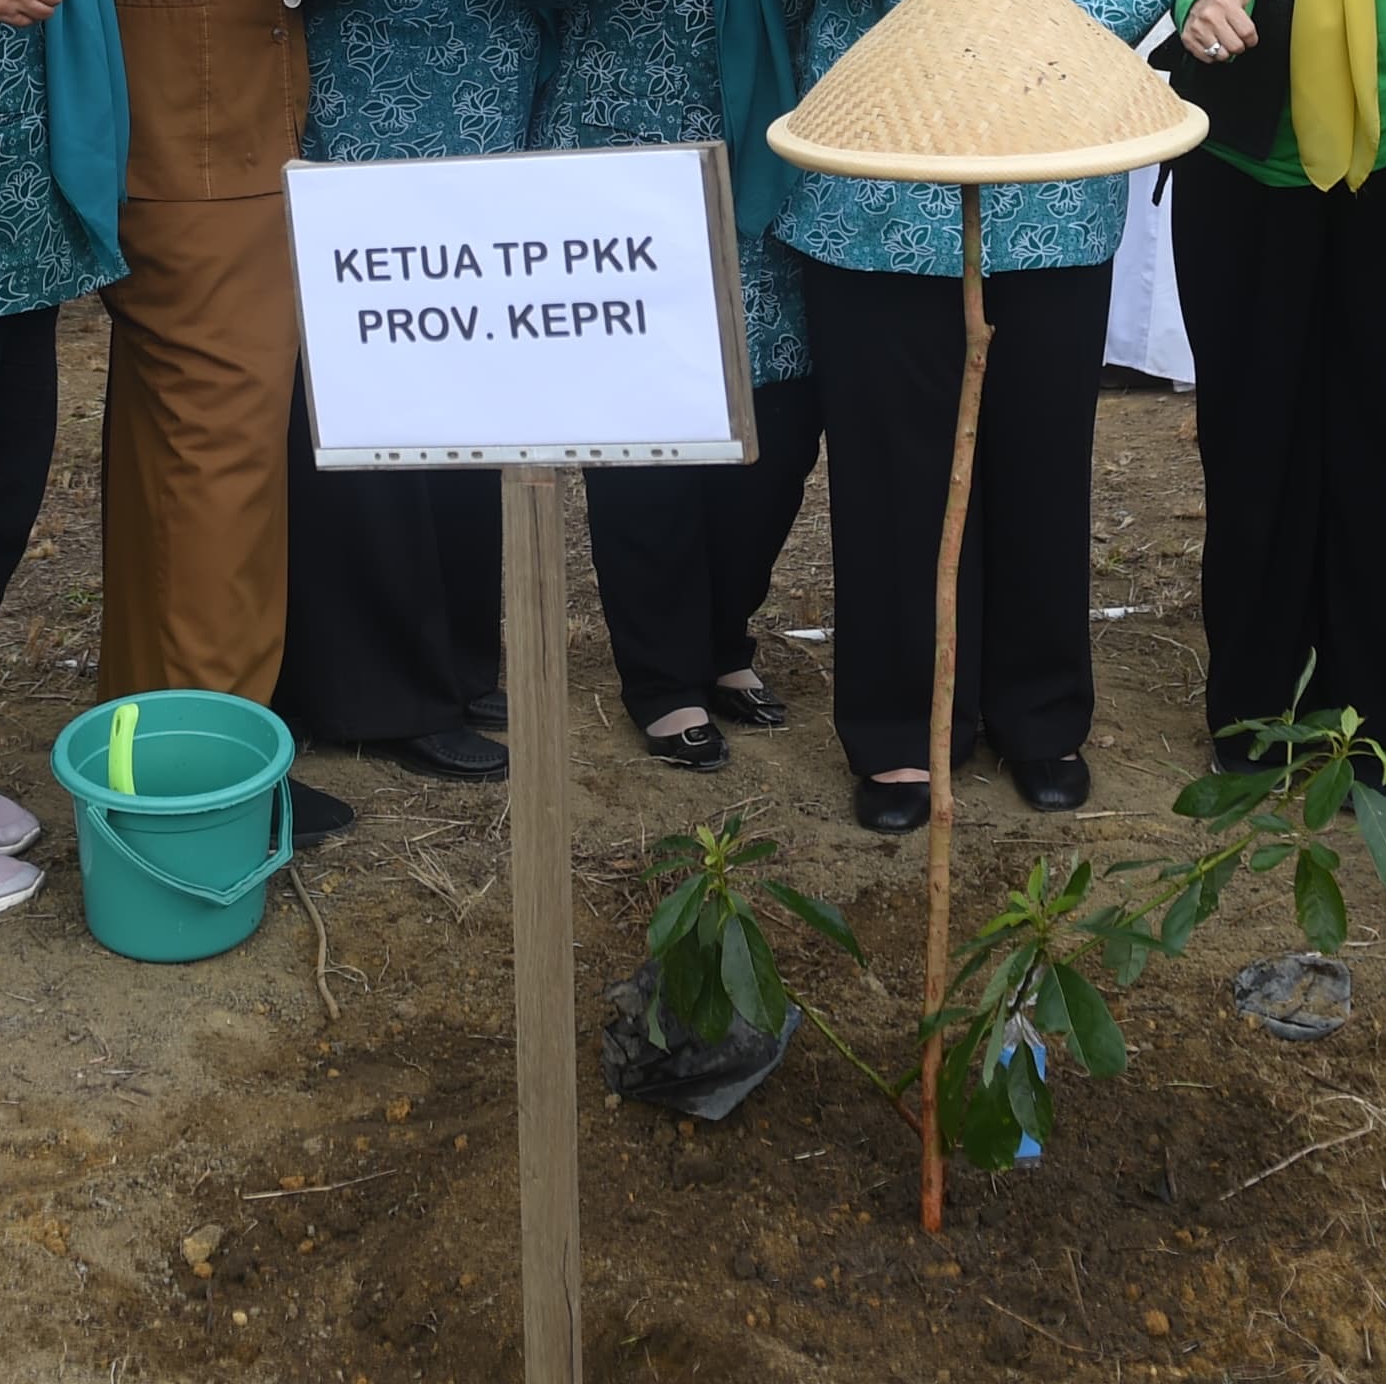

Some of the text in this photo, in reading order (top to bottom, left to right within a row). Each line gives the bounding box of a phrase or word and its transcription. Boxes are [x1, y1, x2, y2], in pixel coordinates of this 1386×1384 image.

[334, 236, 657, 283] KETUA TP PKK
[358, 299, 647, 344] PROV. KEPRI
